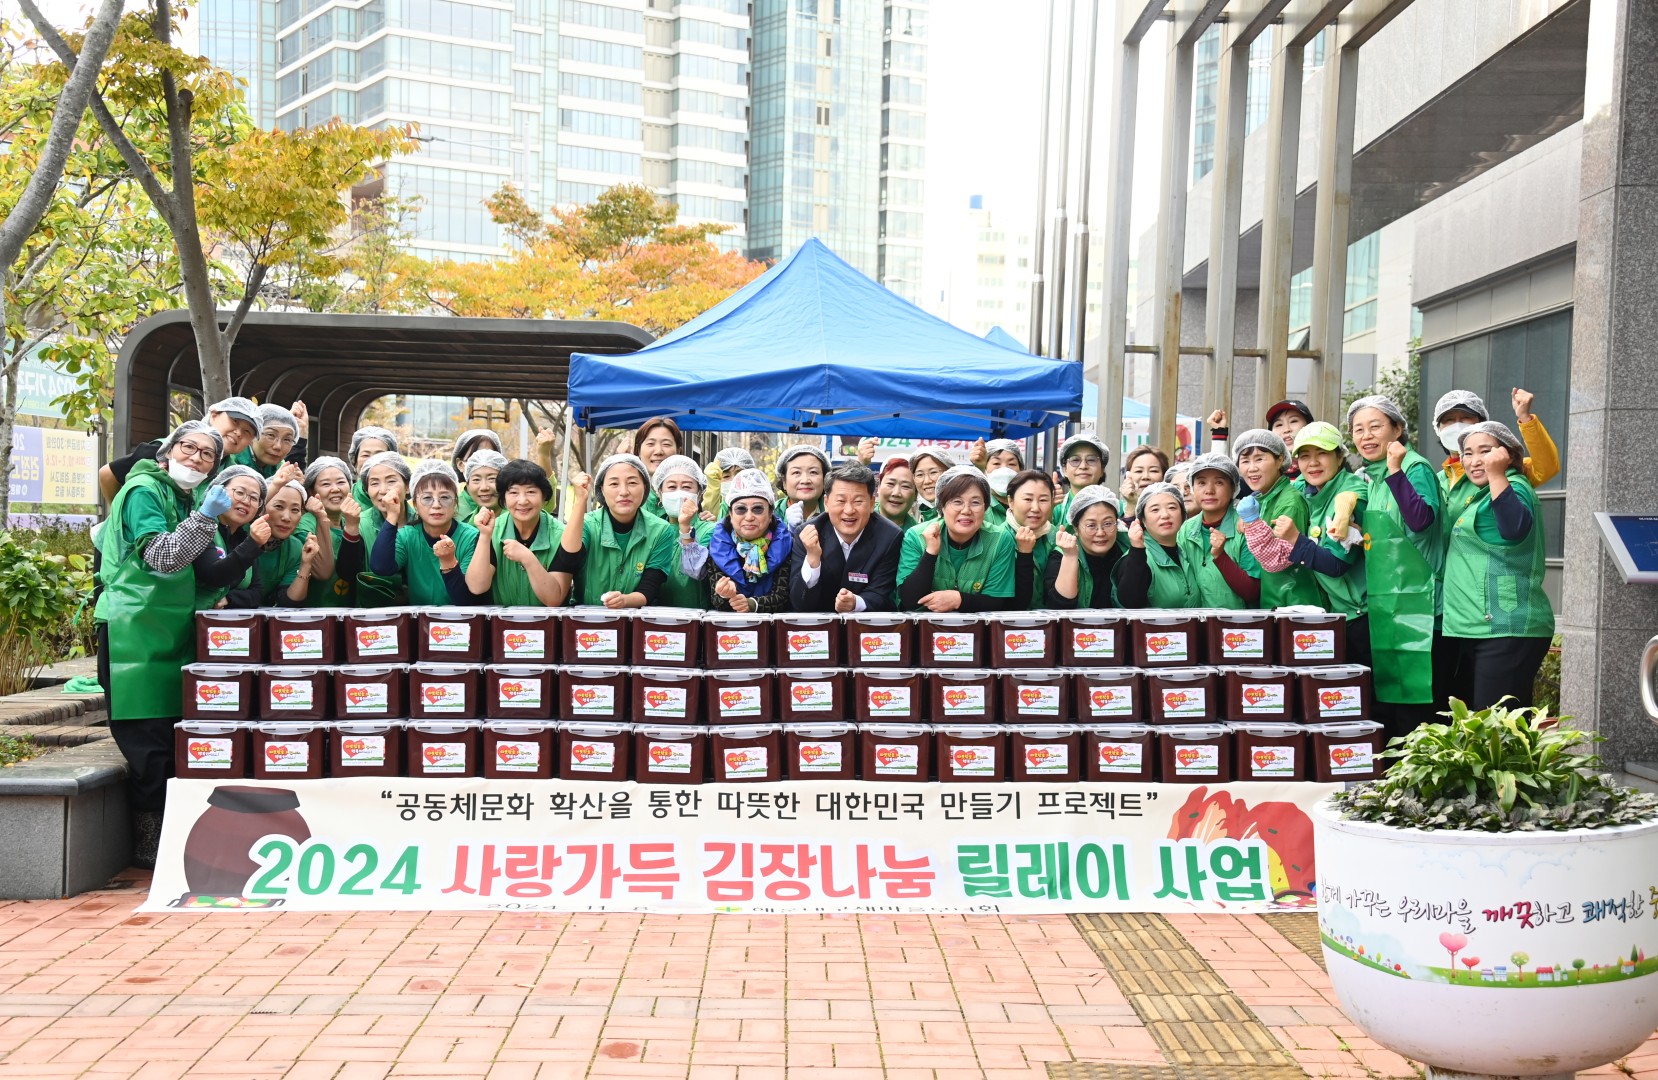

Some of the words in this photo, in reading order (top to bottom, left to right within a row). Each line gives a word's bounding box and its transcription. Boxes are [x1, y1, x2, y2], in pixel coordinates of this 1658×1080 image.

[550, 791, 632, 820] 확산을
[649, 789, 702, 819] 통한
[719, 791, 800, 820] 따뜻한
[817, 791, 924, 821] 대한민국
[941, 791, 1020, 820] 만들기
[251, 840, 421, 900] 2024
[440, 843, 681, 901] 사랑가득
[702, 842, 936, 902] 김장나눔
[957, 842, 1131, 901] 릴레이
[1153, 843, 1268, 902] 사업
[1345, 888, 1392, 918] 가꾸는
[1397, 895, 1477, 935] 우리마을
[1481, 899, 1575, 930] 깨끗하고
[1581, 890, 1645, 924] 쾌적한
